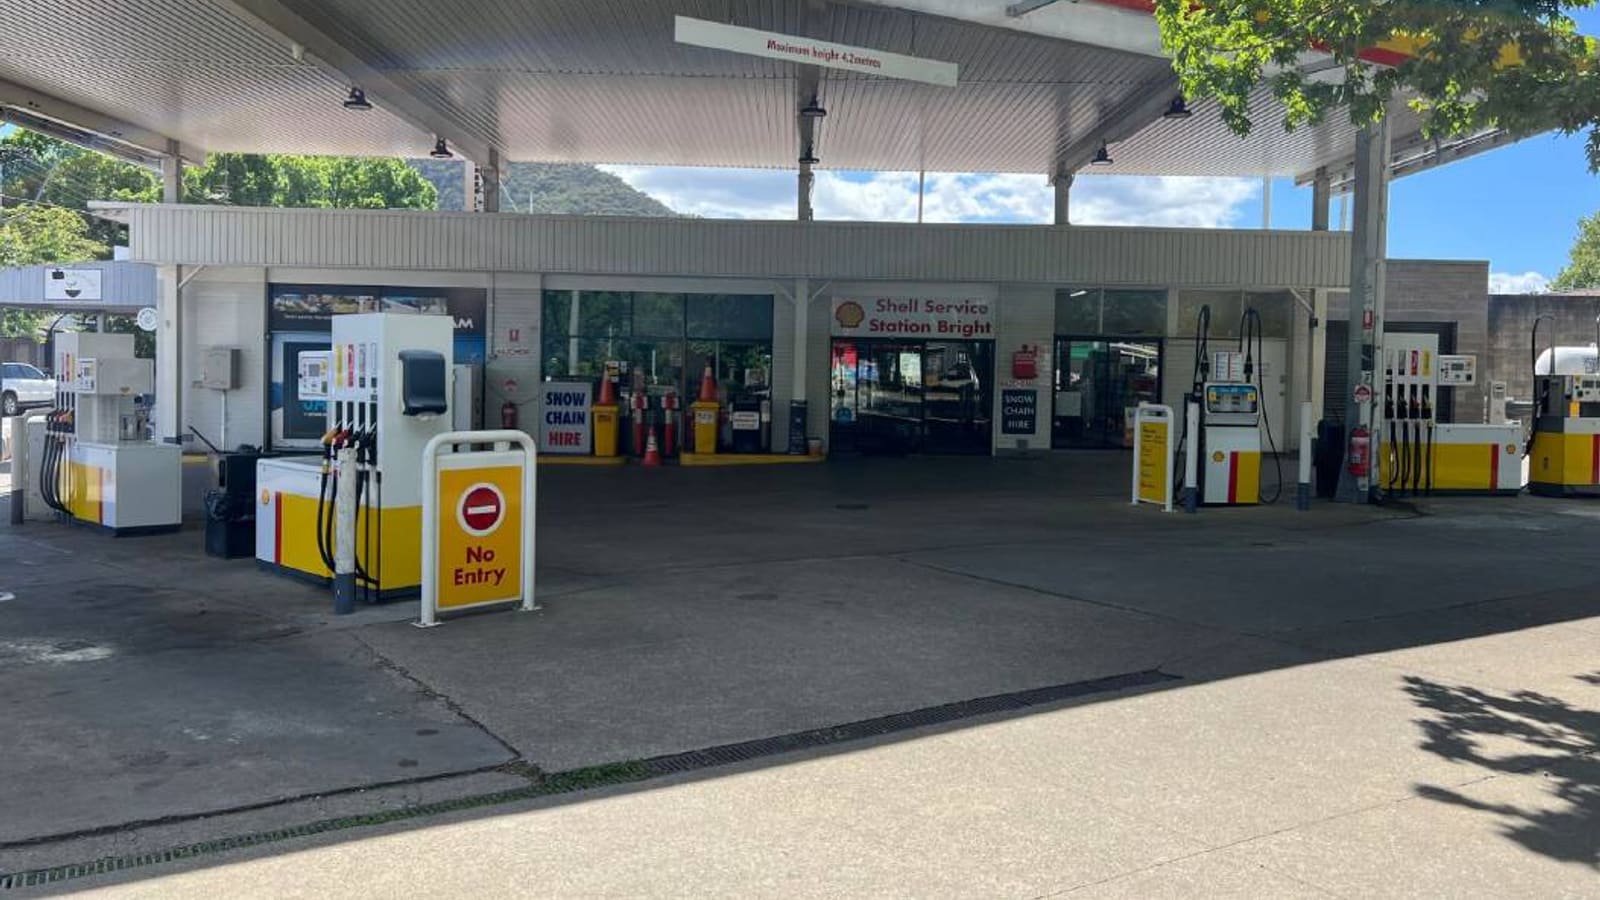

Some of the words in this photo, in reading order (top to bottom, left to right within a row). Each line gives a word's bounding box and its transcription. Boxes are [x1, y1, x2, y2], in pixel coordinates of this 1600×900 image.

[767, 39, 810, 56] Maximum
[812, 46, 839, 61] height
[876, 298, 918, 313] Shell
[925, 300, 988, 314] Service
[869, 318, 931, 333] Station
[937, 320, 991, 337] Bright
[545, 391, 586, 406] SNOW
[1005, 394, 1034, 403] SNOW
[545, 411, 586, 425] CHAIN
[1004, 407, 1035, 416] CHAIN
[1008, 420, 1032, 429] HIRE
[549, 431, 583, 447] HIRE
[466, 547, 495, 564] No
[454, 568, 506, 586] Entry
